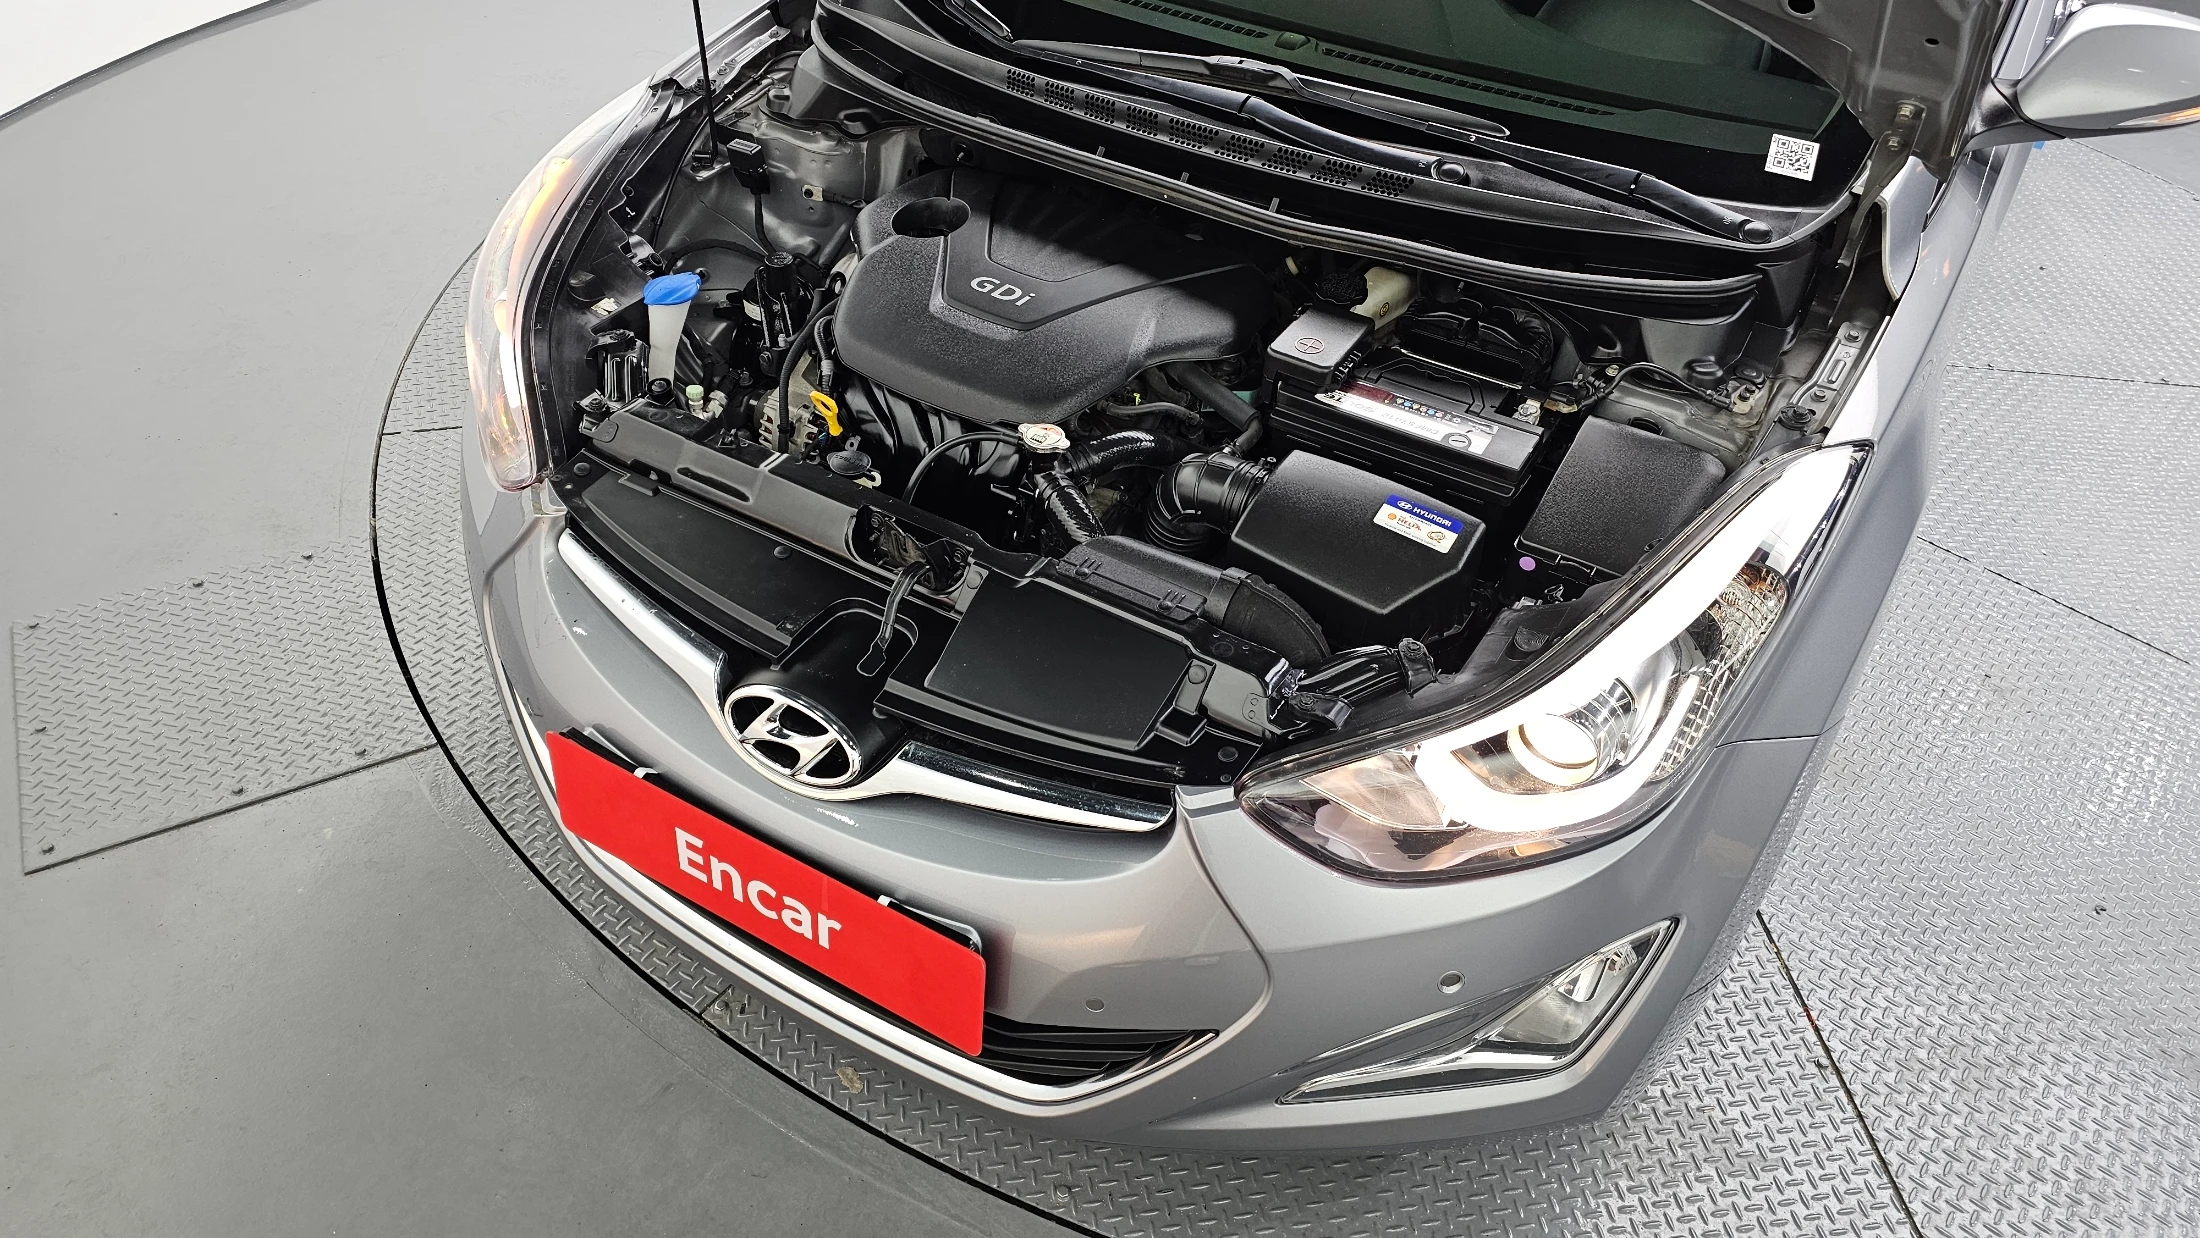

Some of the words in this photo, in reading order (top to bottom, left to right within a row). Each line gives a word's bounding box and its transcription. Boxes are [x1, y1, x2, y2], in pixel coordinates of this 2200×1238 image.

[970, 276, 1036, 306] GDi
[1412, 506, 1452, 528] HYUNDAI
[675, 826, 842, 949] Encar
